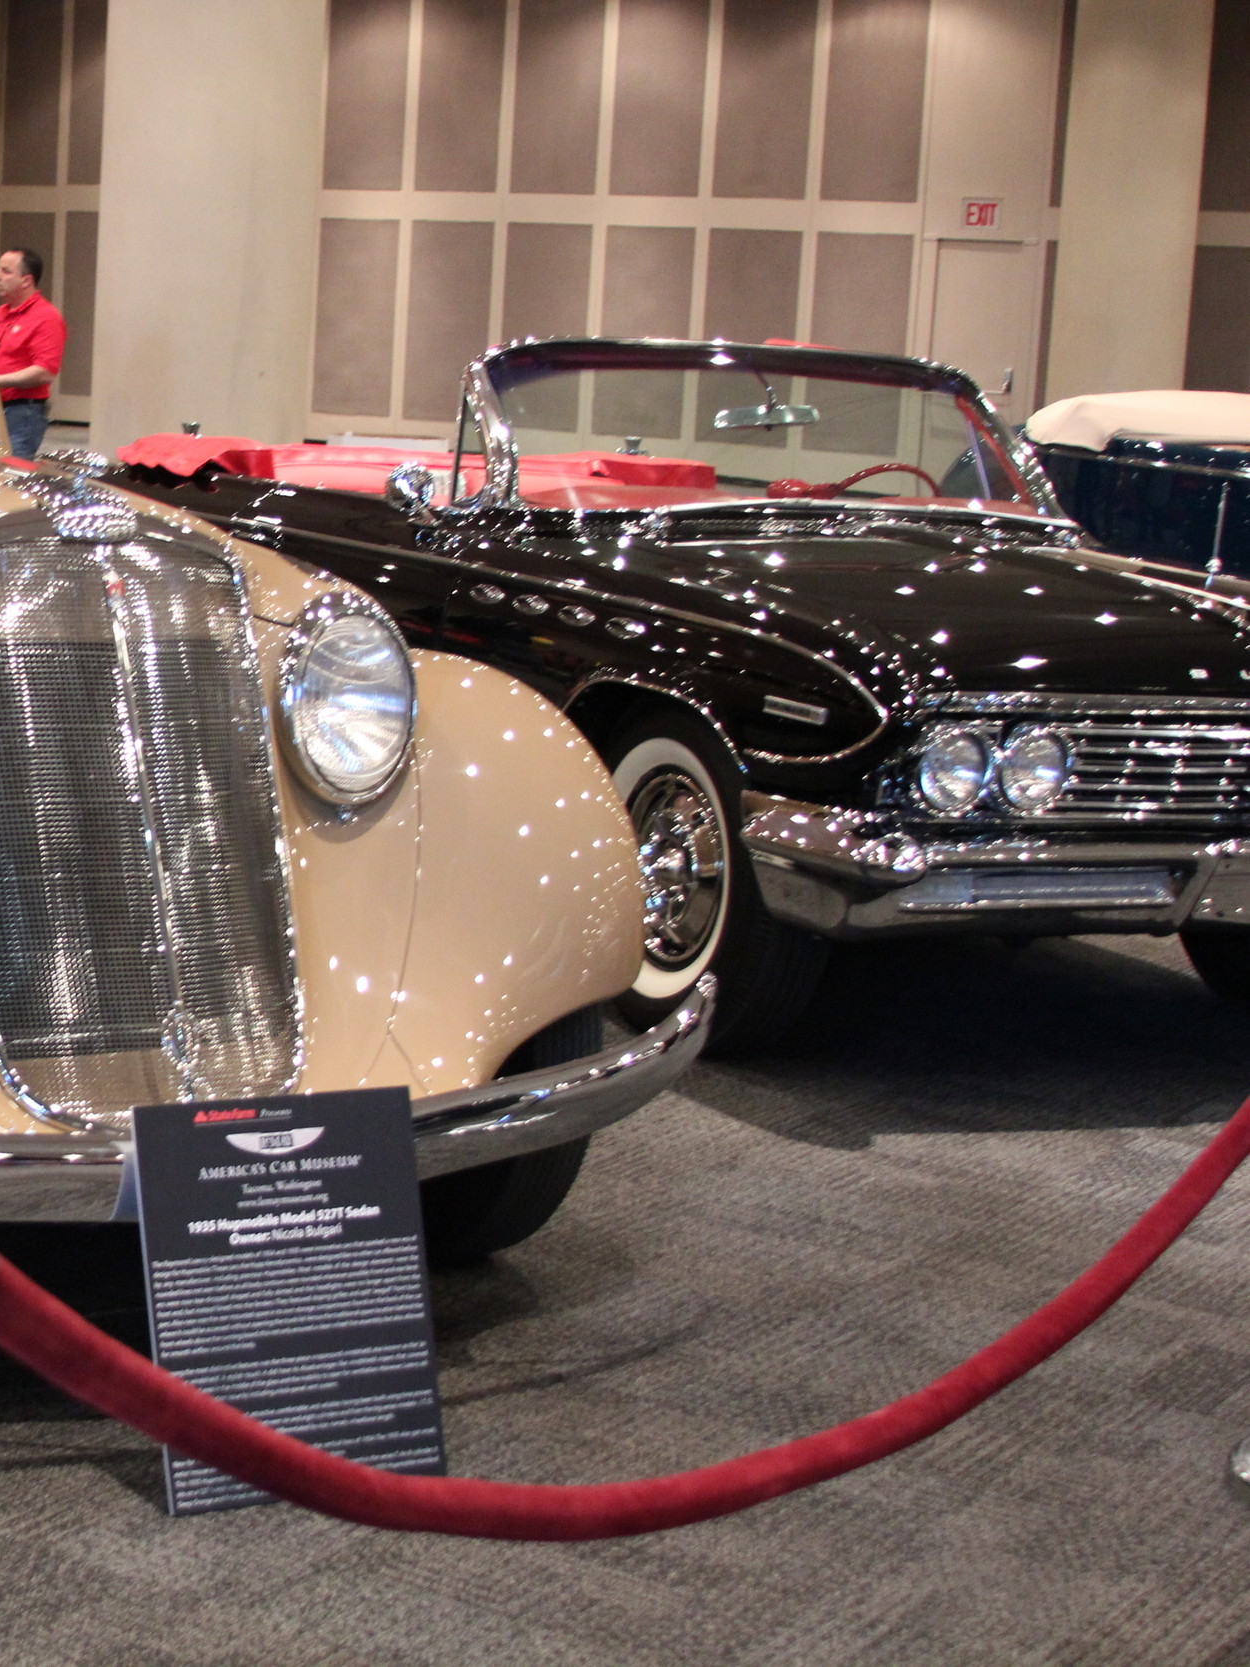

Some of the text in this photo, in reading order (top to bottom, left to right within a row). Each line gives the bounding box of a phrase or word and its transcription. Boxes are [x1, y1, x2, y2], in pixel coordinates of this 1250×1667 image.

[965, 202, 998, 226] EXIT
[187, 1219, 217, 1235] 1935
[216, 1213, 280, 1232] Hupmobile
[280, 1209, 317, 1225] Model
[345, 1203, 381, 1219] Sedan
[228, 1222, 343, 1246] Owner: Nicola Bulgari
